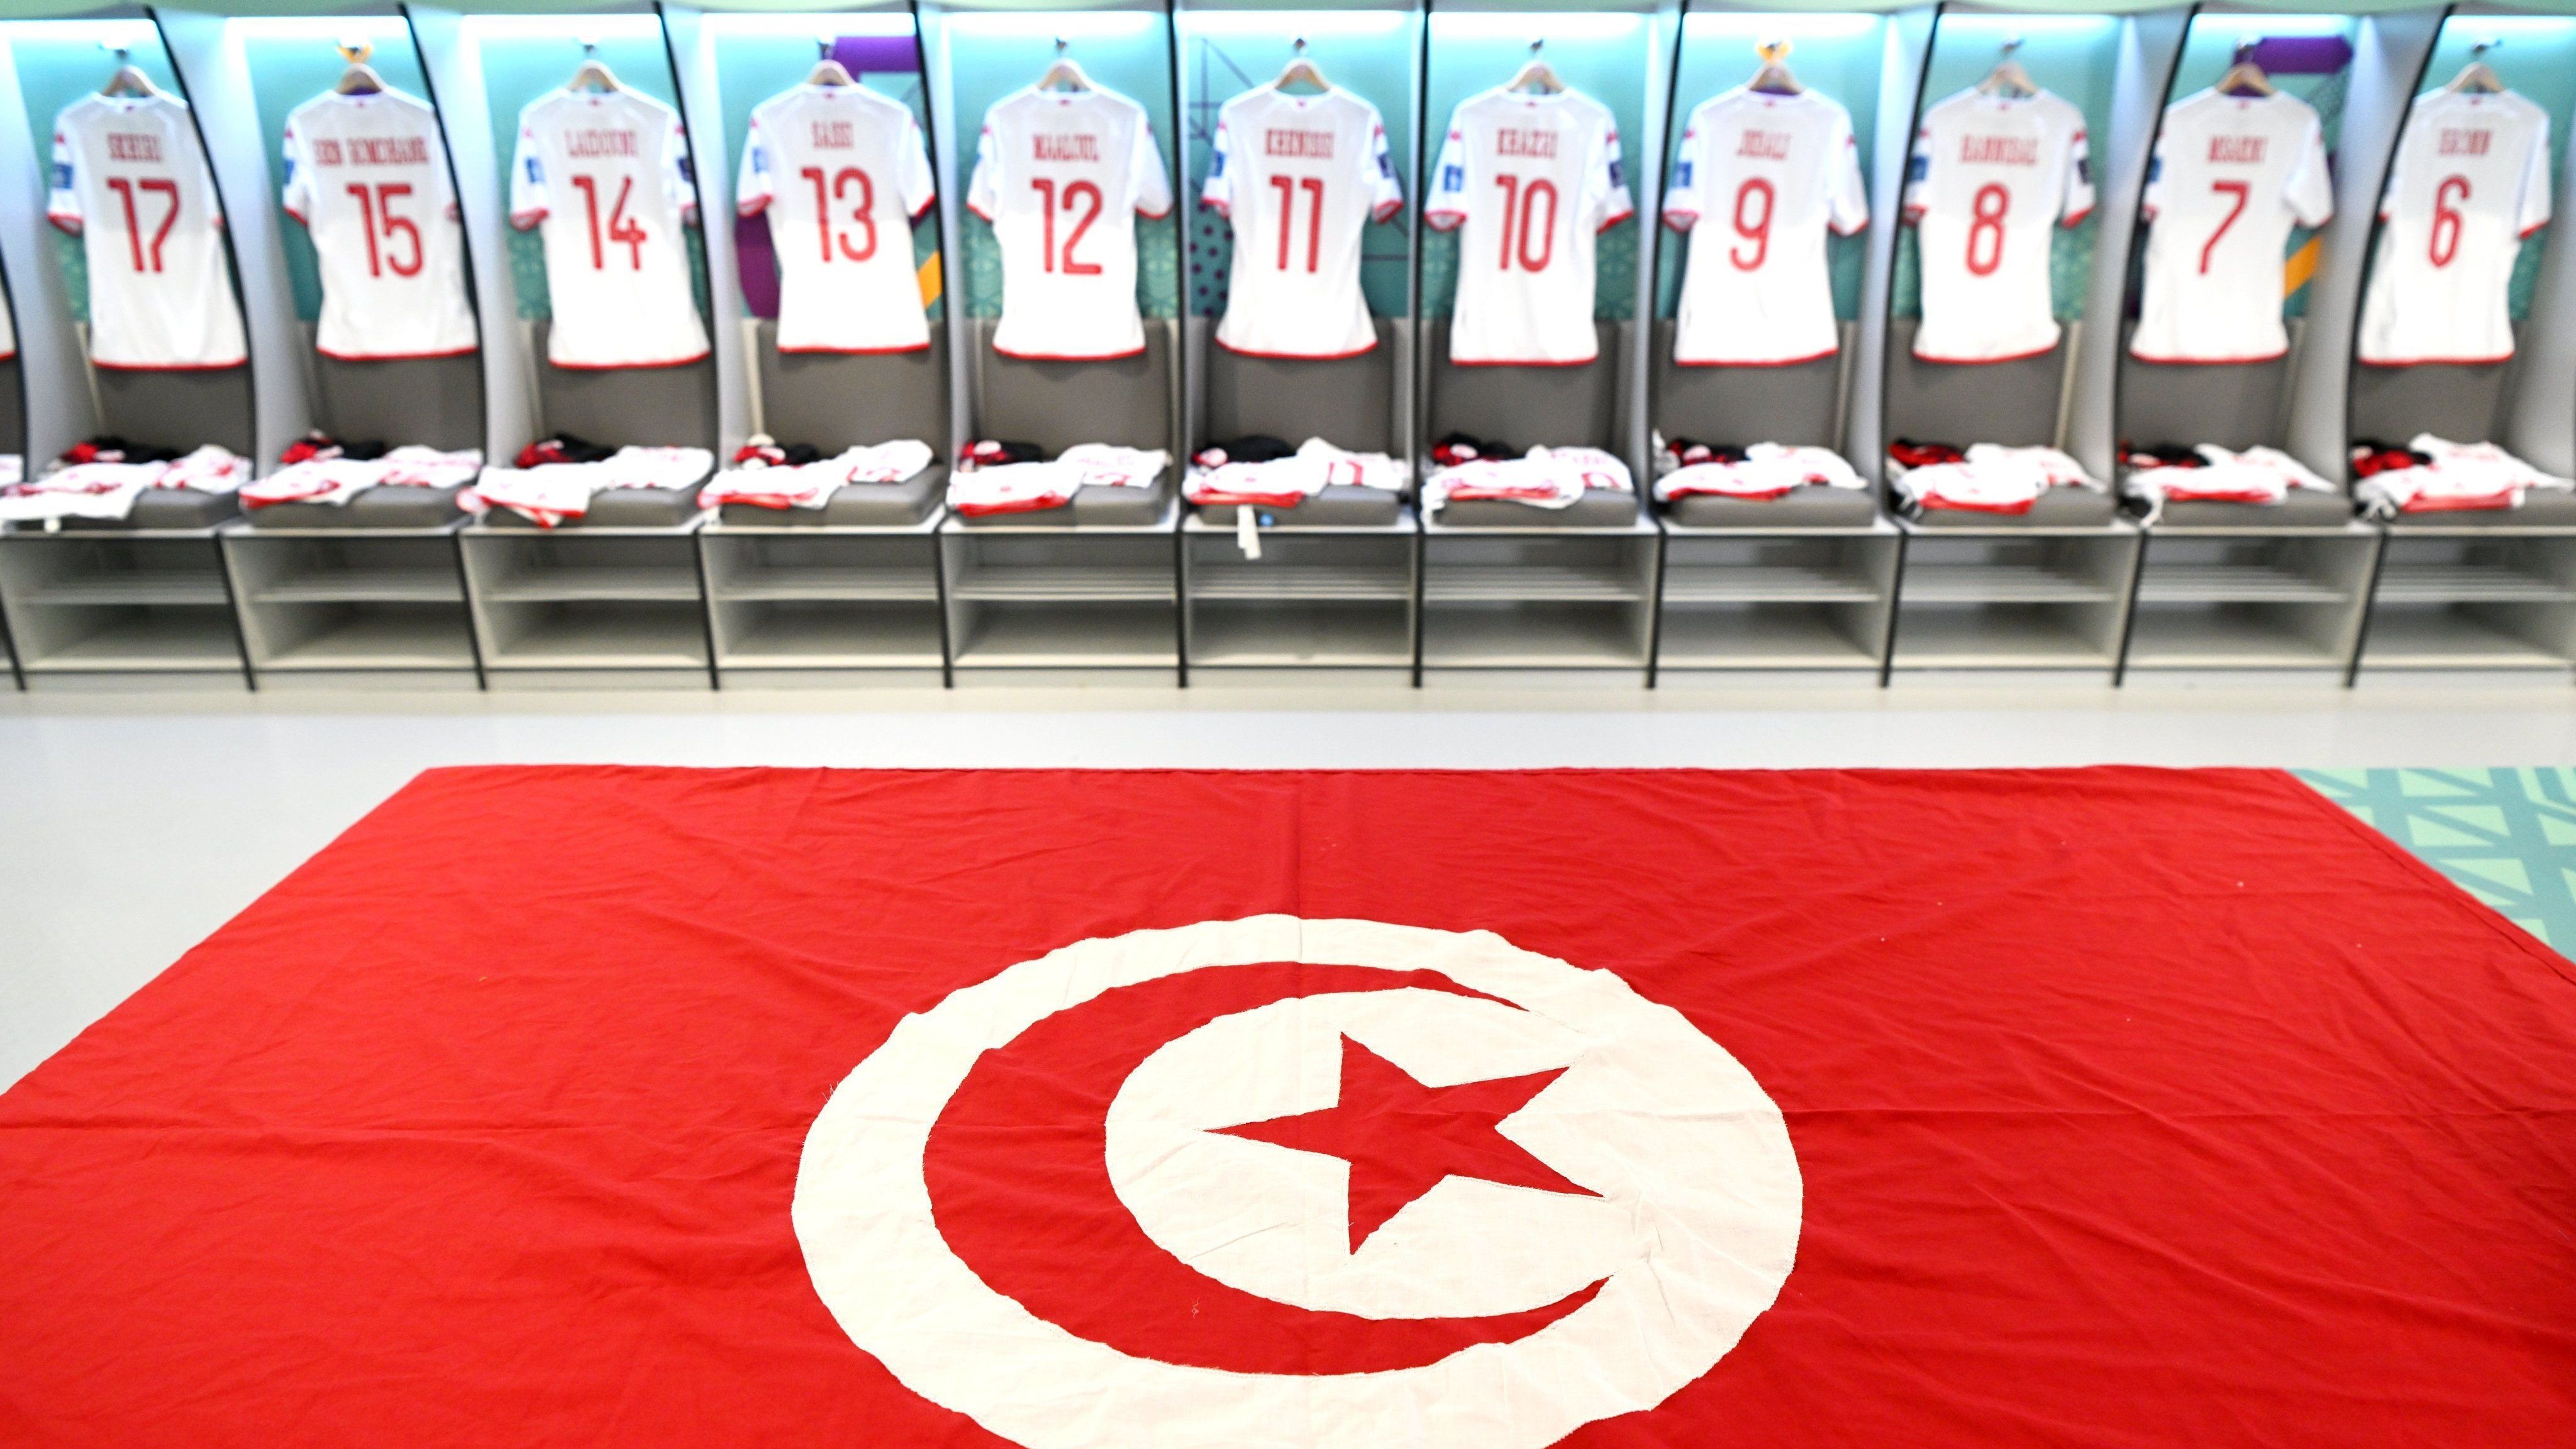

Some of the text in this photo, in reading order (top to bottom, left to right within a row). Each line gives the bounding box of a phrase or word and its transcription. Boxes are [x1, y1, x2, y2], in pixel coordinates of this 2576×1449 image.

[106, 177, 180, 272] 17
[347, 183, 423, 277] 15
[572, 175, 647, 270] 14
[801, 167, 877, 262] 13
[1031, 178, 1104, 275] 12
[1270, 175, 1324, 272] 11
[1496, 174, 1558, 273] 10
[1729, 177, 1775, 272] 9
[1965, 182, 2010, 277] 8
[2199, 180, 2250, 274] 7
[2428, 175, 2472, 269] 6
